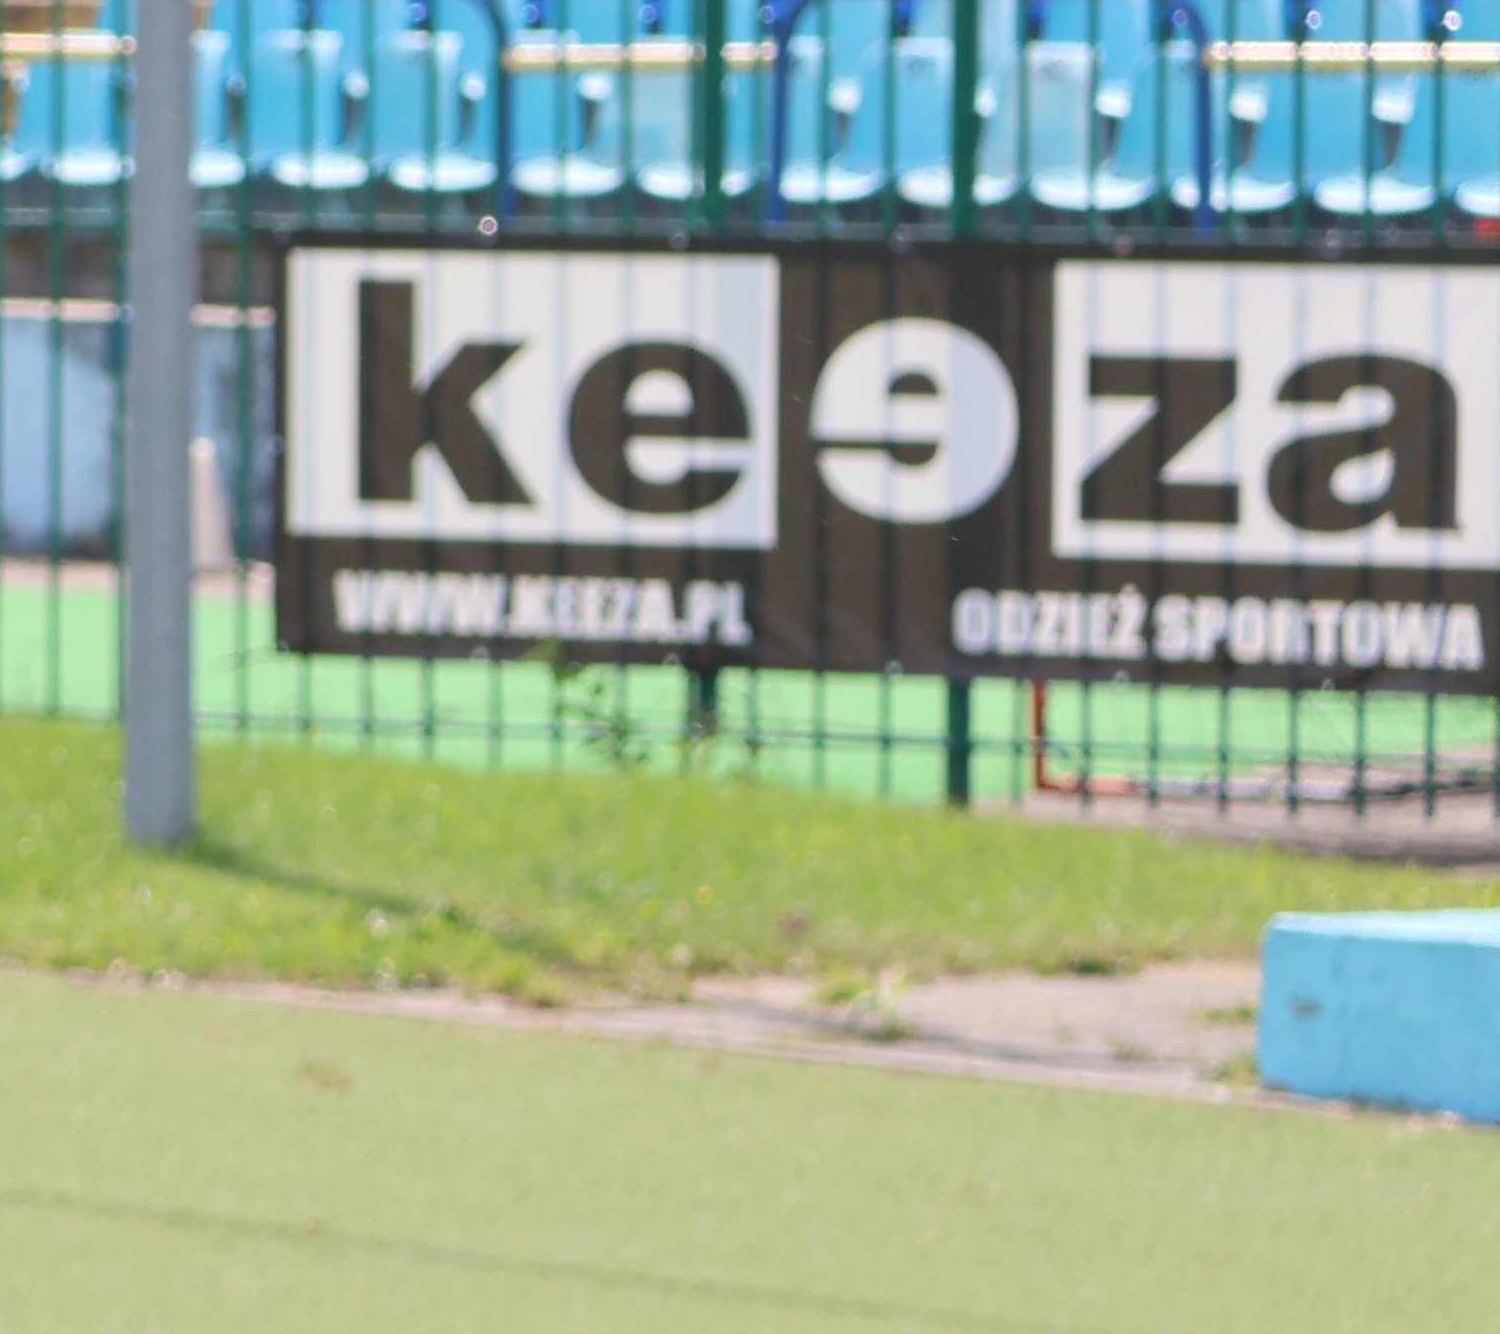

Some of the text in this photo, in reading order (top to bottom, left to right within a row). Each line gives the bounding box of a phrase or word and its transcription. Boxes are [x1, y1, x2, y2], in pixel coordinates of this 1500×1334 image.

[356, 278, 1465, 534] keeza
[332, 569, 753, 646] WWW.KEEZA.PL
[951, 584, 1484, 670] ODZIEŻ SPORTOWA
